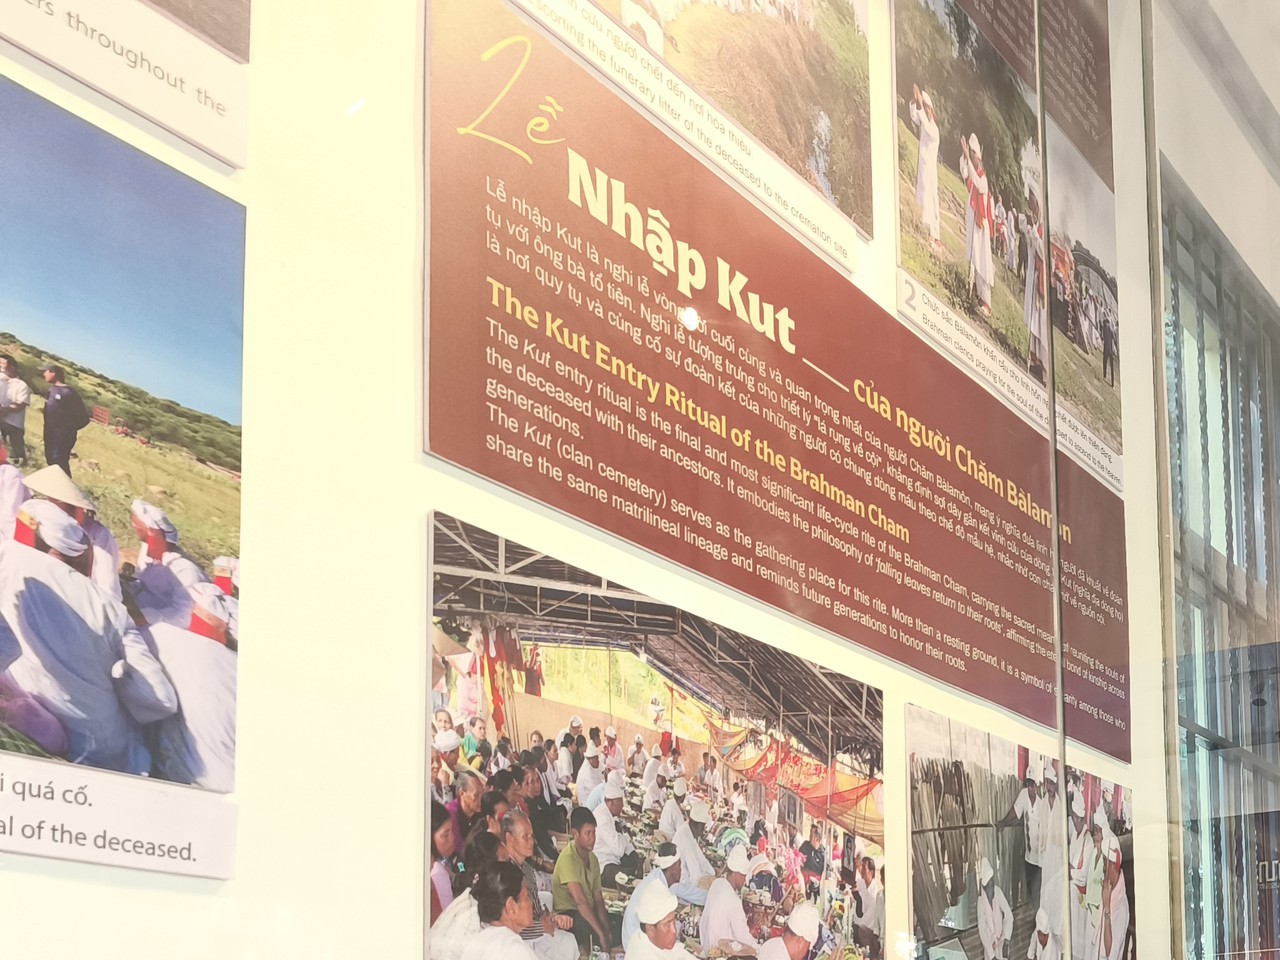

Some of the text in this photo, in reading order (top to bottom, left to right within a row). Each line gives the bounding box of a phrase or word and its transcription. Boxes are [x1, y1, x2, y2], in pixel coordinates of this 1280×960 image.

[66, 10, 227, 117] throughout the
[456, 34, 564, 164] Lễ
[486, 175, 507, 203] Lễ
[512, 195, 551, 233] nhập
[556, 221, 582, 254] Kut
[586, 240, 600, 265] là
[603, 256, 633, 287] nghi
[637, 274, 650, 297] lễ
[695, 127, 712, 149] the
[714, 143, 761, 188] deceased
[762, 181, 773, 197] to
[773, 191, 789, 211] the
[790, 205, 832, 246] cremation
[485, 203, 670, 336] tụ với ông bà tổ tiên. Nghi
[486, 229, 662, 353] là nơi quy tụ và củng cố
[566, 147, 797, 354] Nhập Kut
[903, 279, 917, 312] 2
[485, 315, 671, 435] The Kut entry ritual is the
[921, 312, 953, 345] Brahman
[485, 377, 584, 440] generations.
[485, 345, 724, 488] the deceased with their ancestors.
[485, 400, 667, 509] The Kut (clan cemetery)
[486, 275, 909, 543] The Kut Entry Ritual of the Brahman Cham
[853, 378, 1072, 545] của người Chăm Bàlamn
[485, 433, 680, 537] share the same matrilineal
[12, 780, 55, 802] quá
[62, 785, 93, 807] cố.
[21, 820, 46, 840] of
[51, 823, 87, 846] the
[94, 830, 197, 862] deceased.
